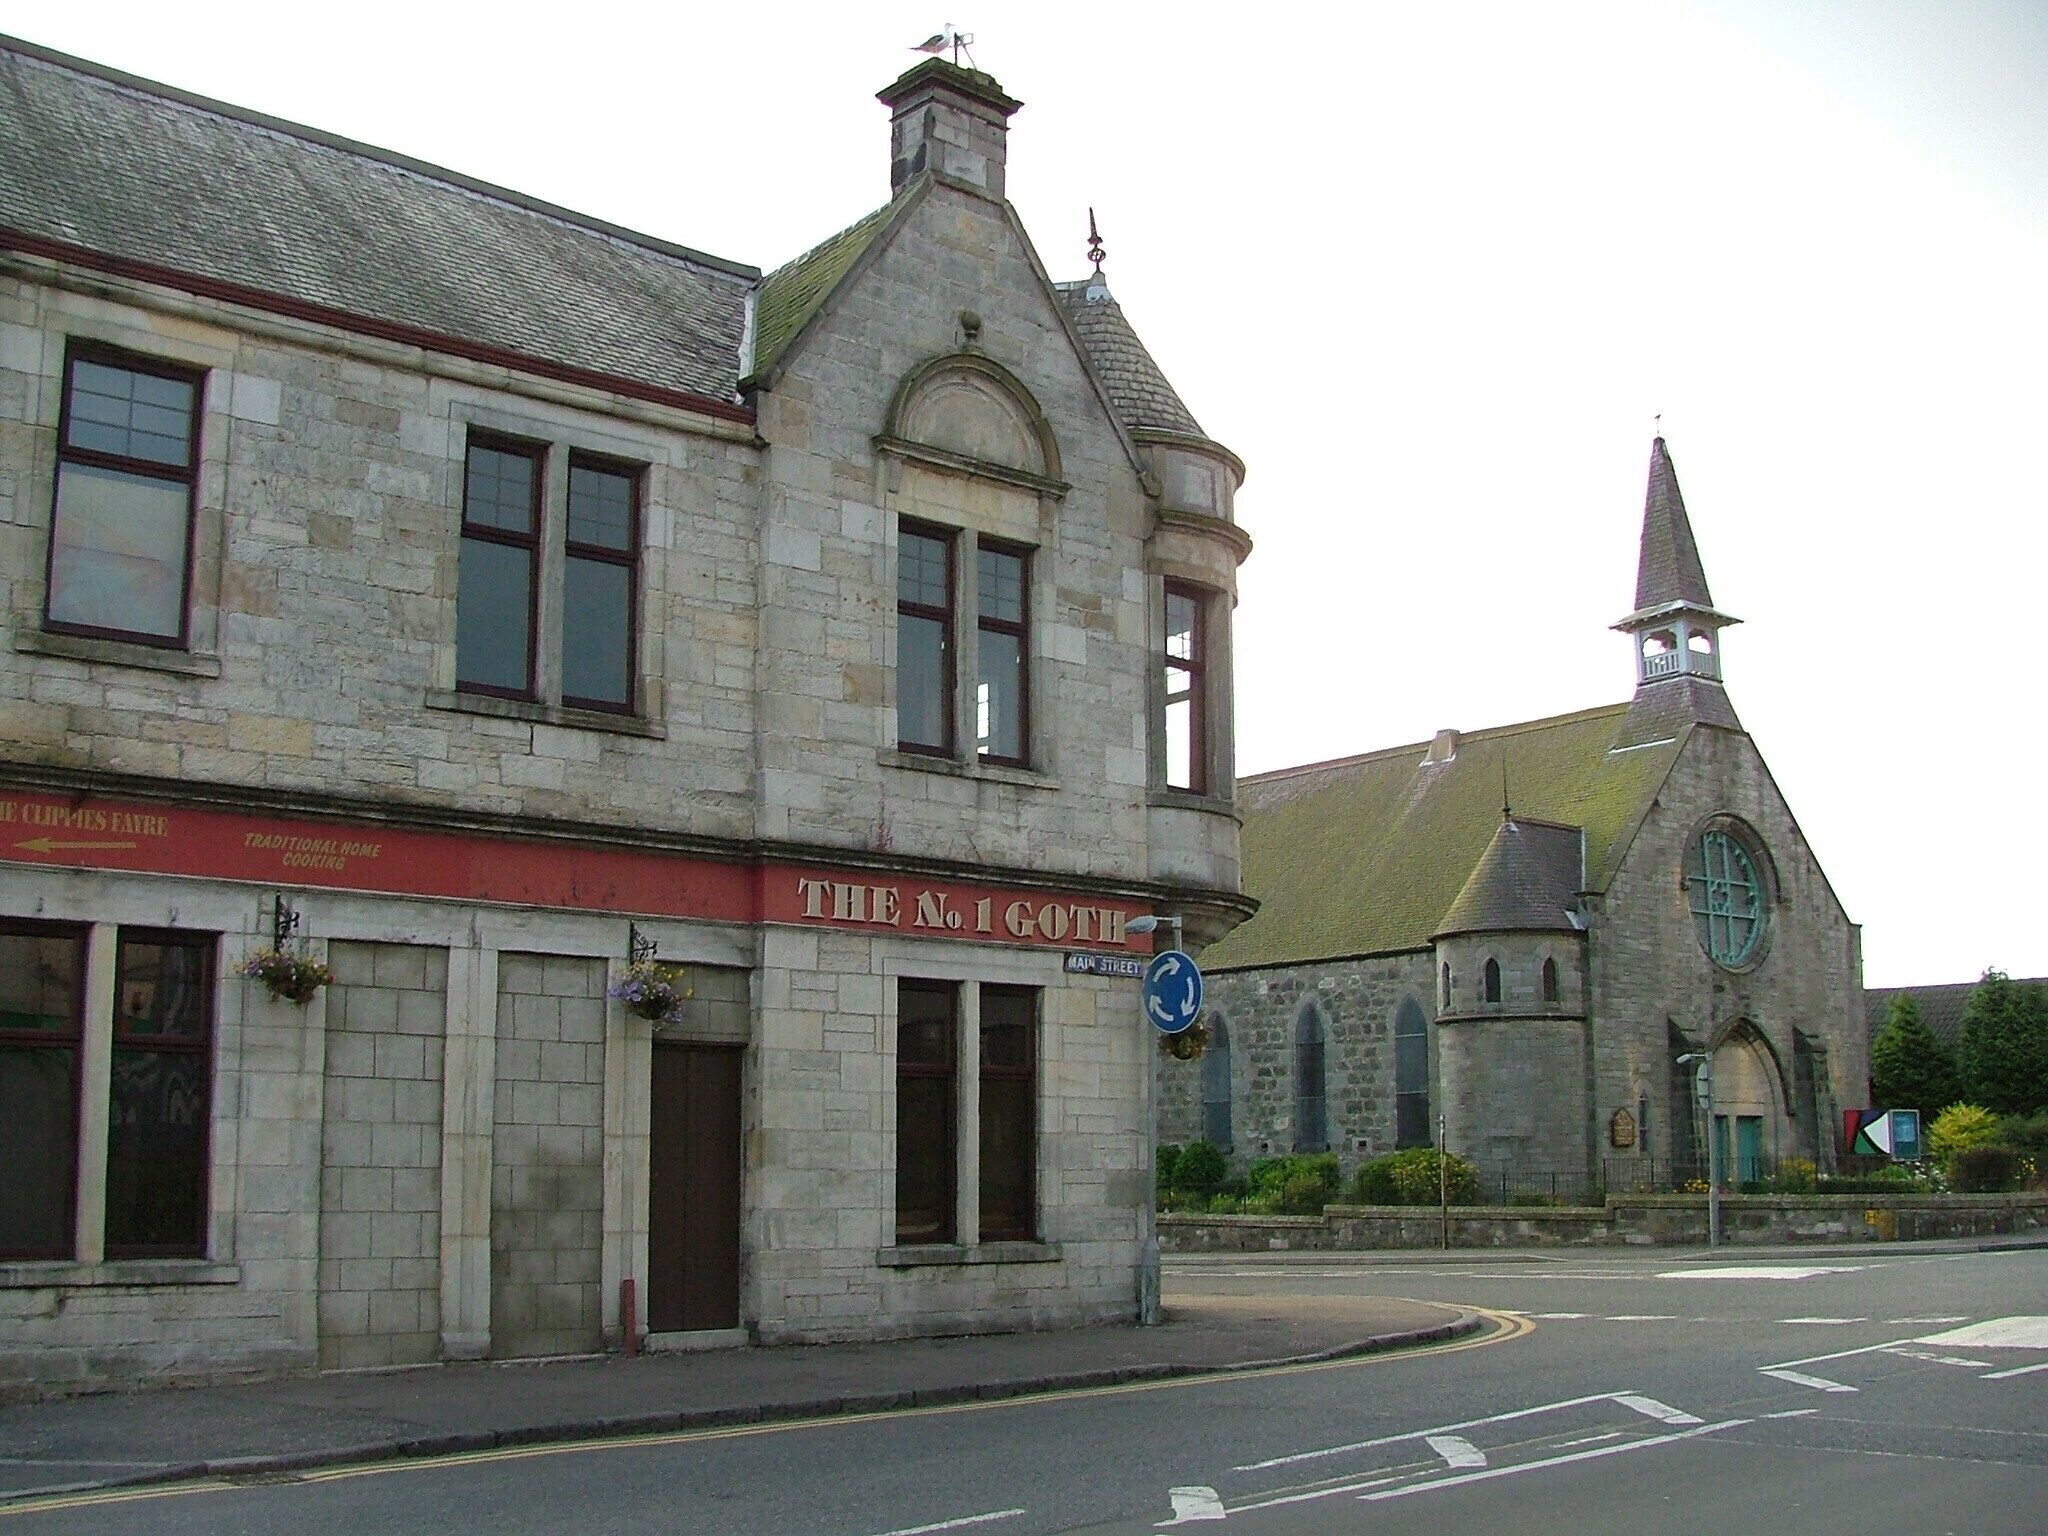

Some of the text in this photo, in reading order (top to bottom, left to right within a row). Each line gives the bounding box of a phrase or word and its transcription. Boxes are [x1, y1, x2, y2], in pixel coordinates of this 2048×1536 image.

[245, 832, 382, 858] TRADITIONAL HOME
[282, 851, 346, 870] COOKING
[797, 877, 1127, 945] THE No. 1 GOTH
[1069, 955, 1140, 974] MAIN STREET
